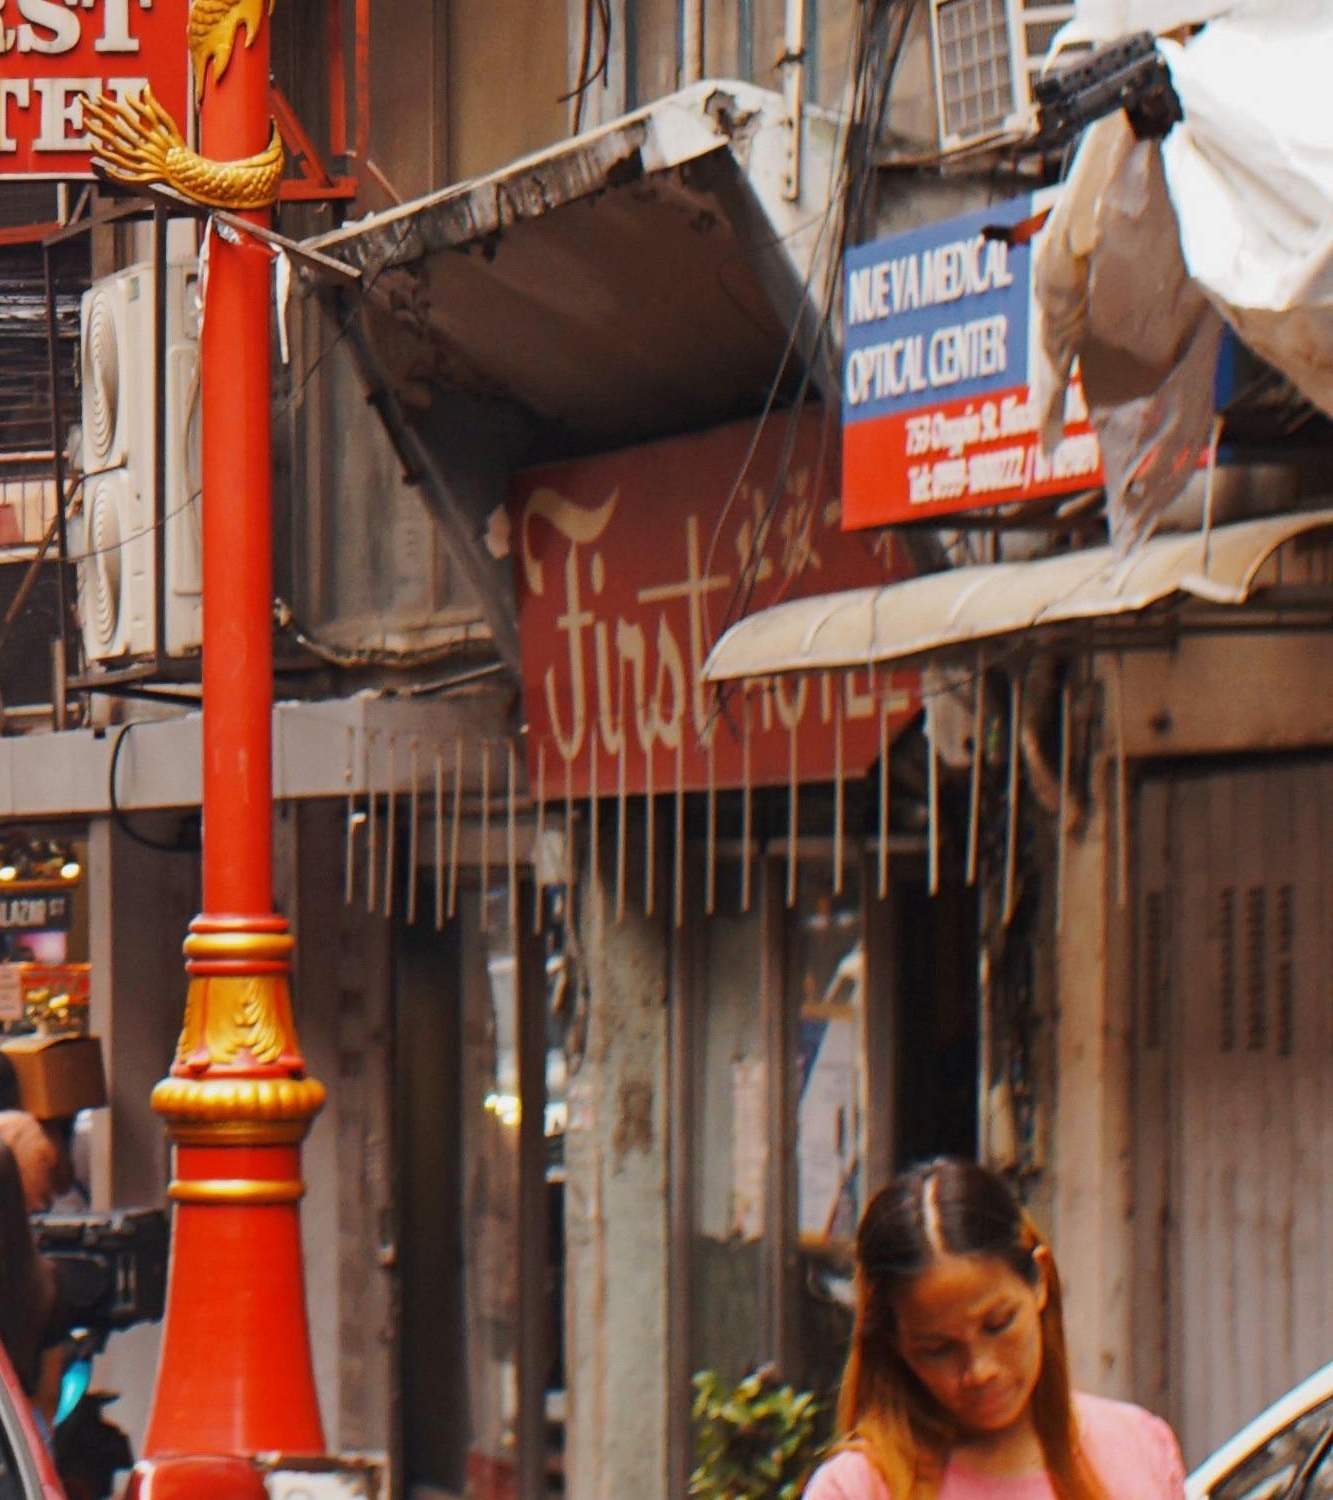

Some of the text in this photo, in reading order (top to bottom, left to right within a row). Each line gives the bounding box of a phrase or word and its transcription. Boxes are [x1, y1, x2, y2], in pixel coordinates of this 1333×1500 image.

[848, 232, 1015, 326] NUEVA MEDICAL
[847, 314, 1009, 406] OPTICAL CENTER
[522, 484, 730, 761] First
